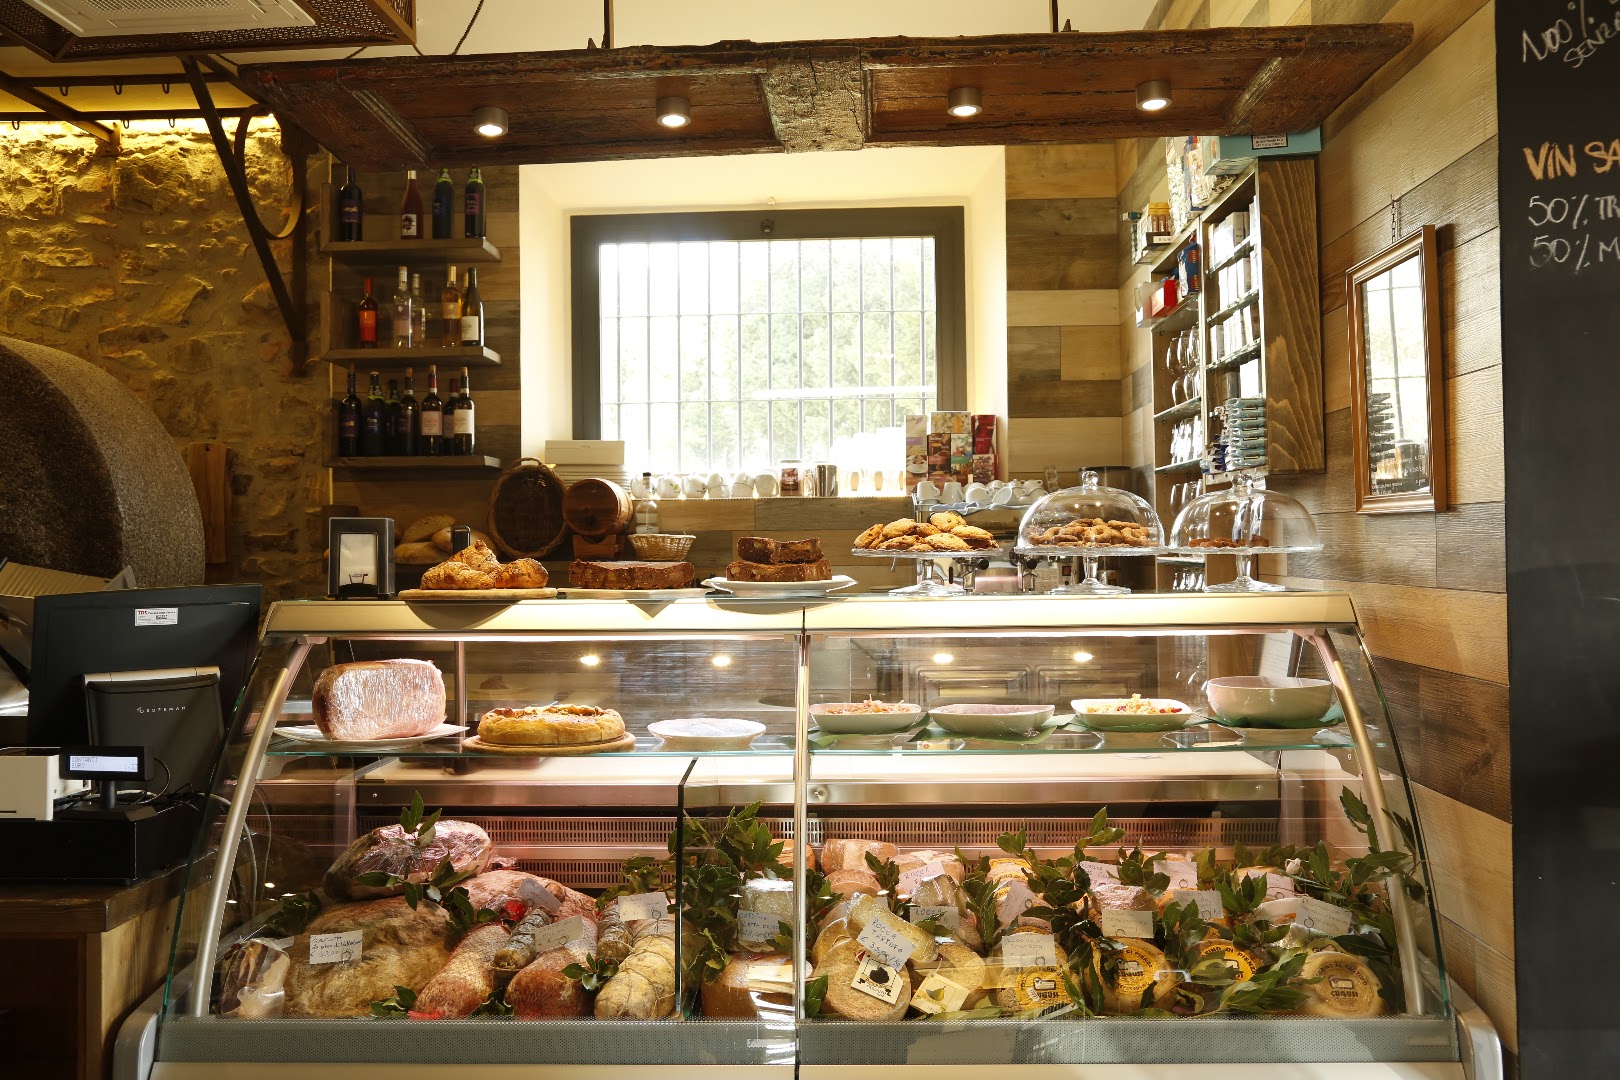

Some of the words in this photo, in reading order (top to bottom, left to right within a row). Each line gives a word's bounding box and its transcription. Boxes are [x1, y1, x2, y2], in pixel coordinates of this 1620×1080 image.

[1523, 140, 1577, 181] VIN
[1528, 194, 1589, 230] 50%
[1529, 233, 1590, 275] 50%
[872, 918, 897, 940] ROCCA
[872, 928, 903, 953] TARTUFO
